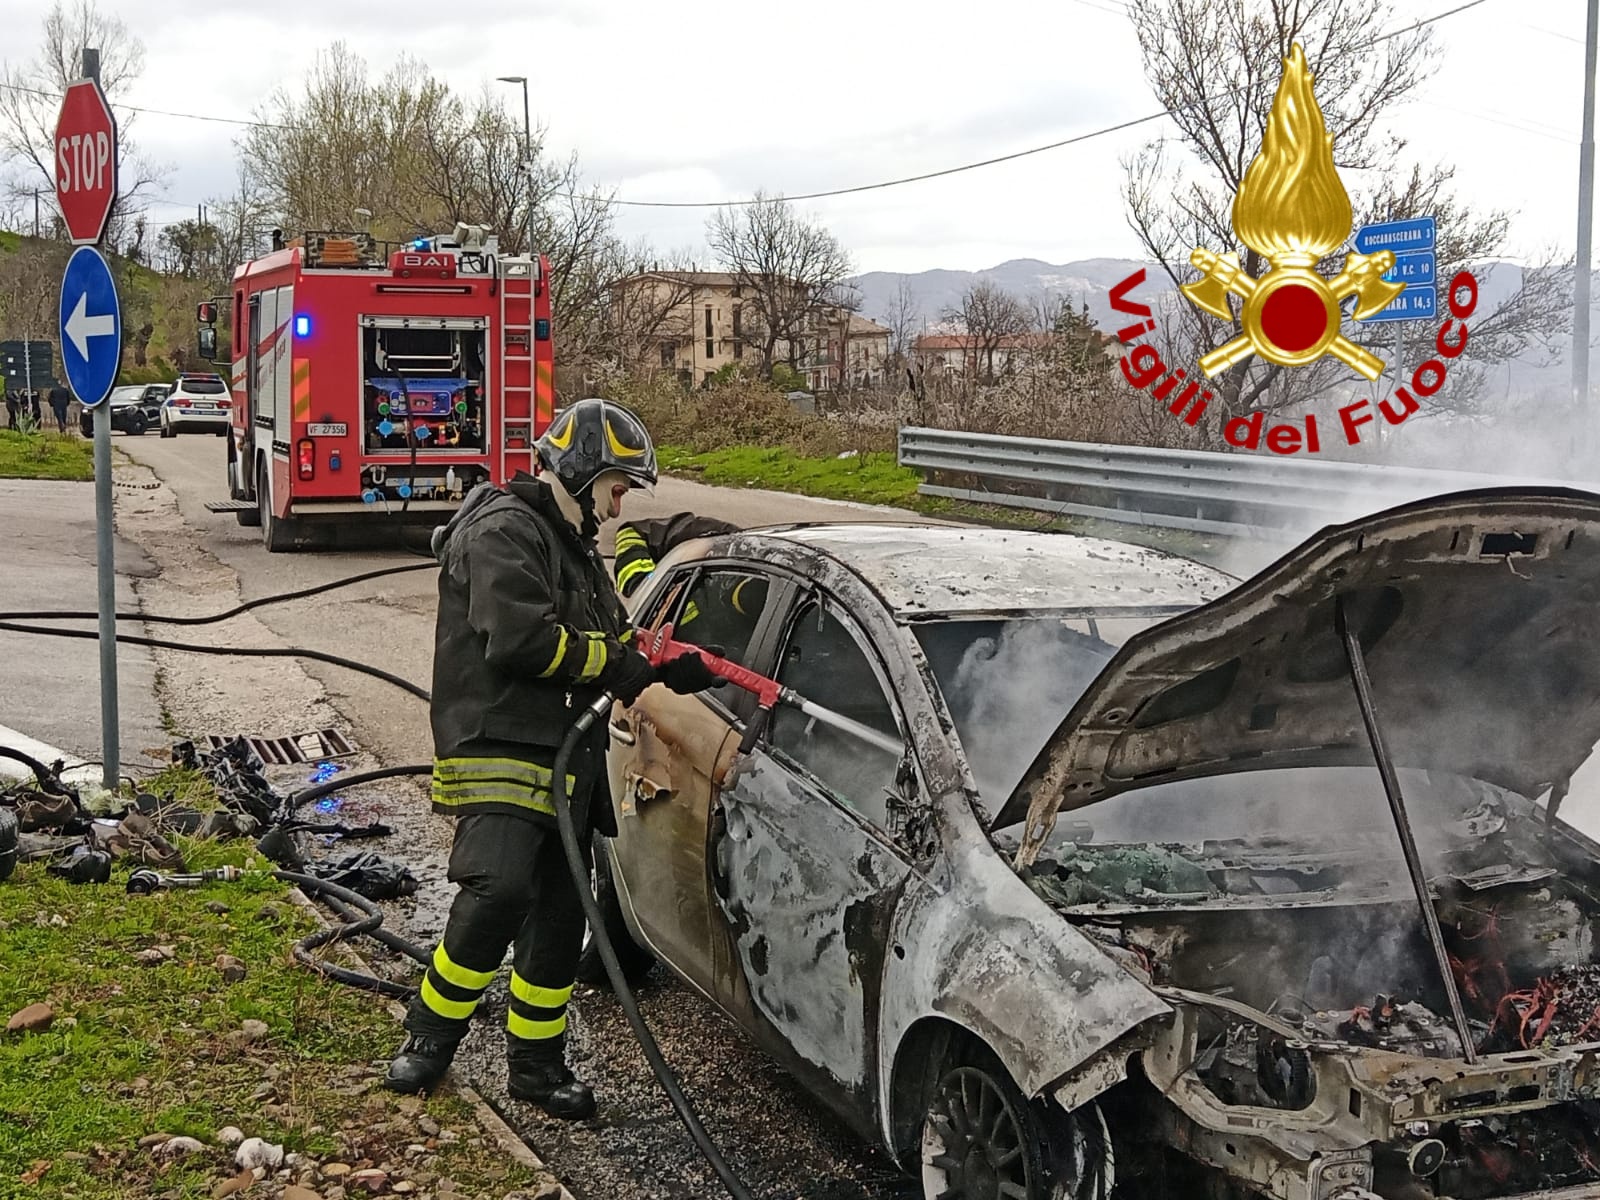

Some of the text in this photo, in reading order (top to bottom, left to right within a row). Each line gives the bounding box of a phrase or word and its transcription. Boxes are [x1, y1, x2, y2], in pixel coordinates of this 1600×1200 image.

[59, 131, 109, 193] STOP
[404, 255, 448, 267] BAI
[1421, 263, 1430, 274] 10
